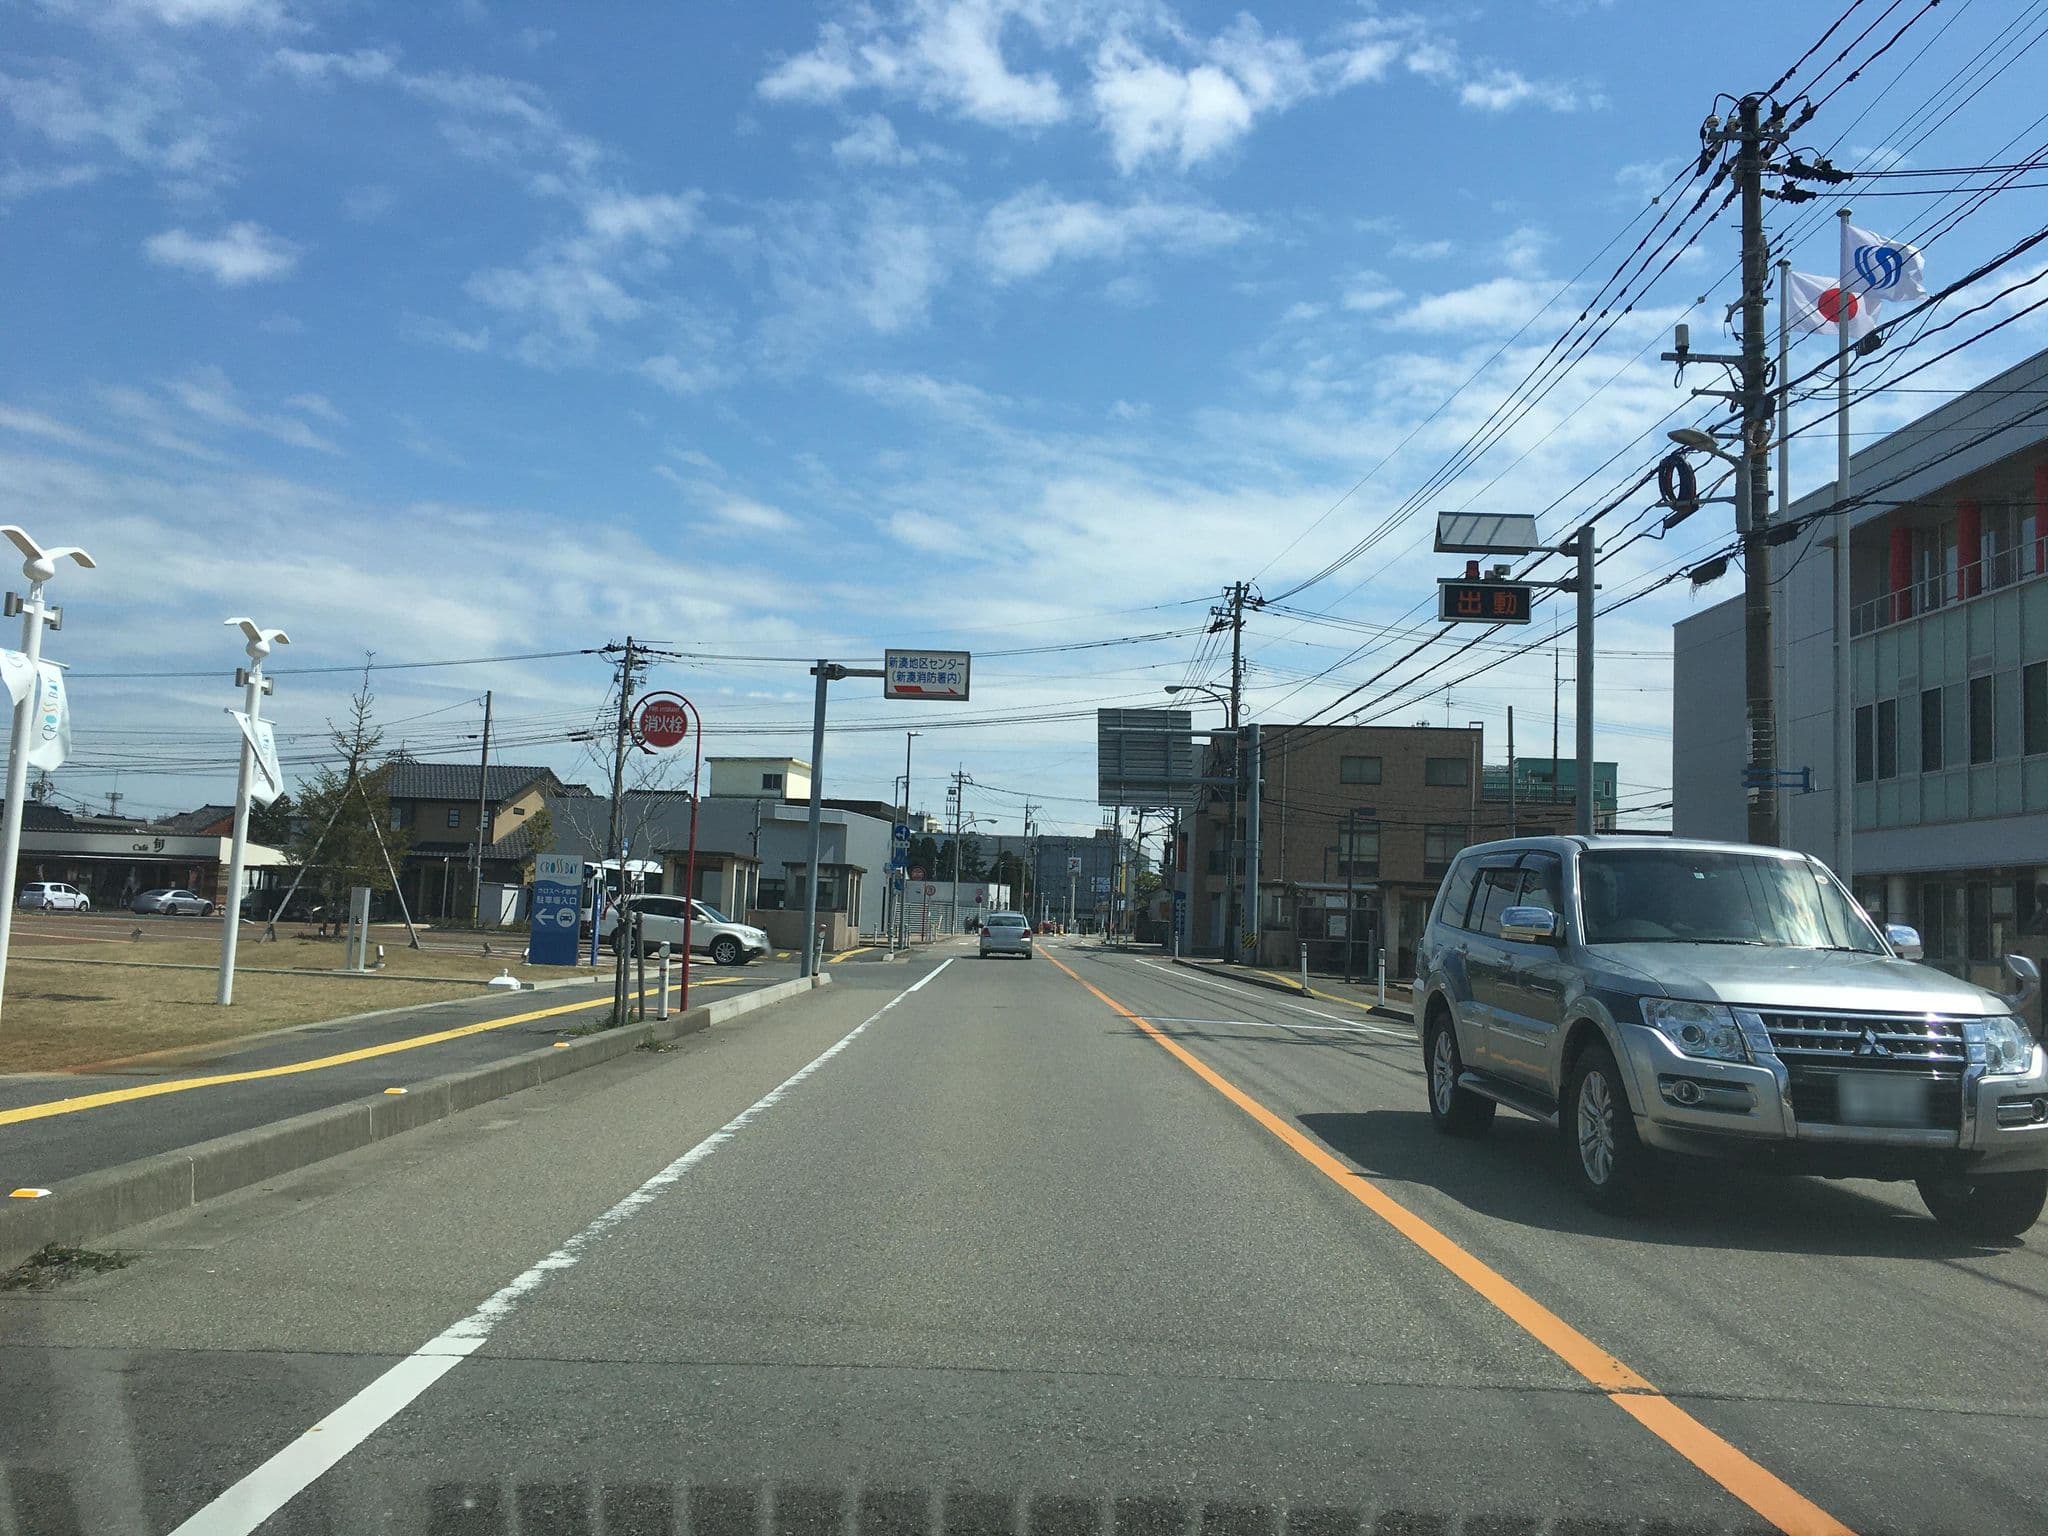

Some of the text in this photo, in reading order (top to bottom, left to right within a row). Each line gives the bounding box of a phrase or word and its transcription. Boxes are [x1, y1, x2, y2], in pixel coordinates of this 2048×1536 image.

[1457, 590, 1517, 614] 出動
[888, 656, 965, 670] 新湊地区センター
[644, 714, 684, 734] 消火栓
[153, 838, 165, 853] 旬
